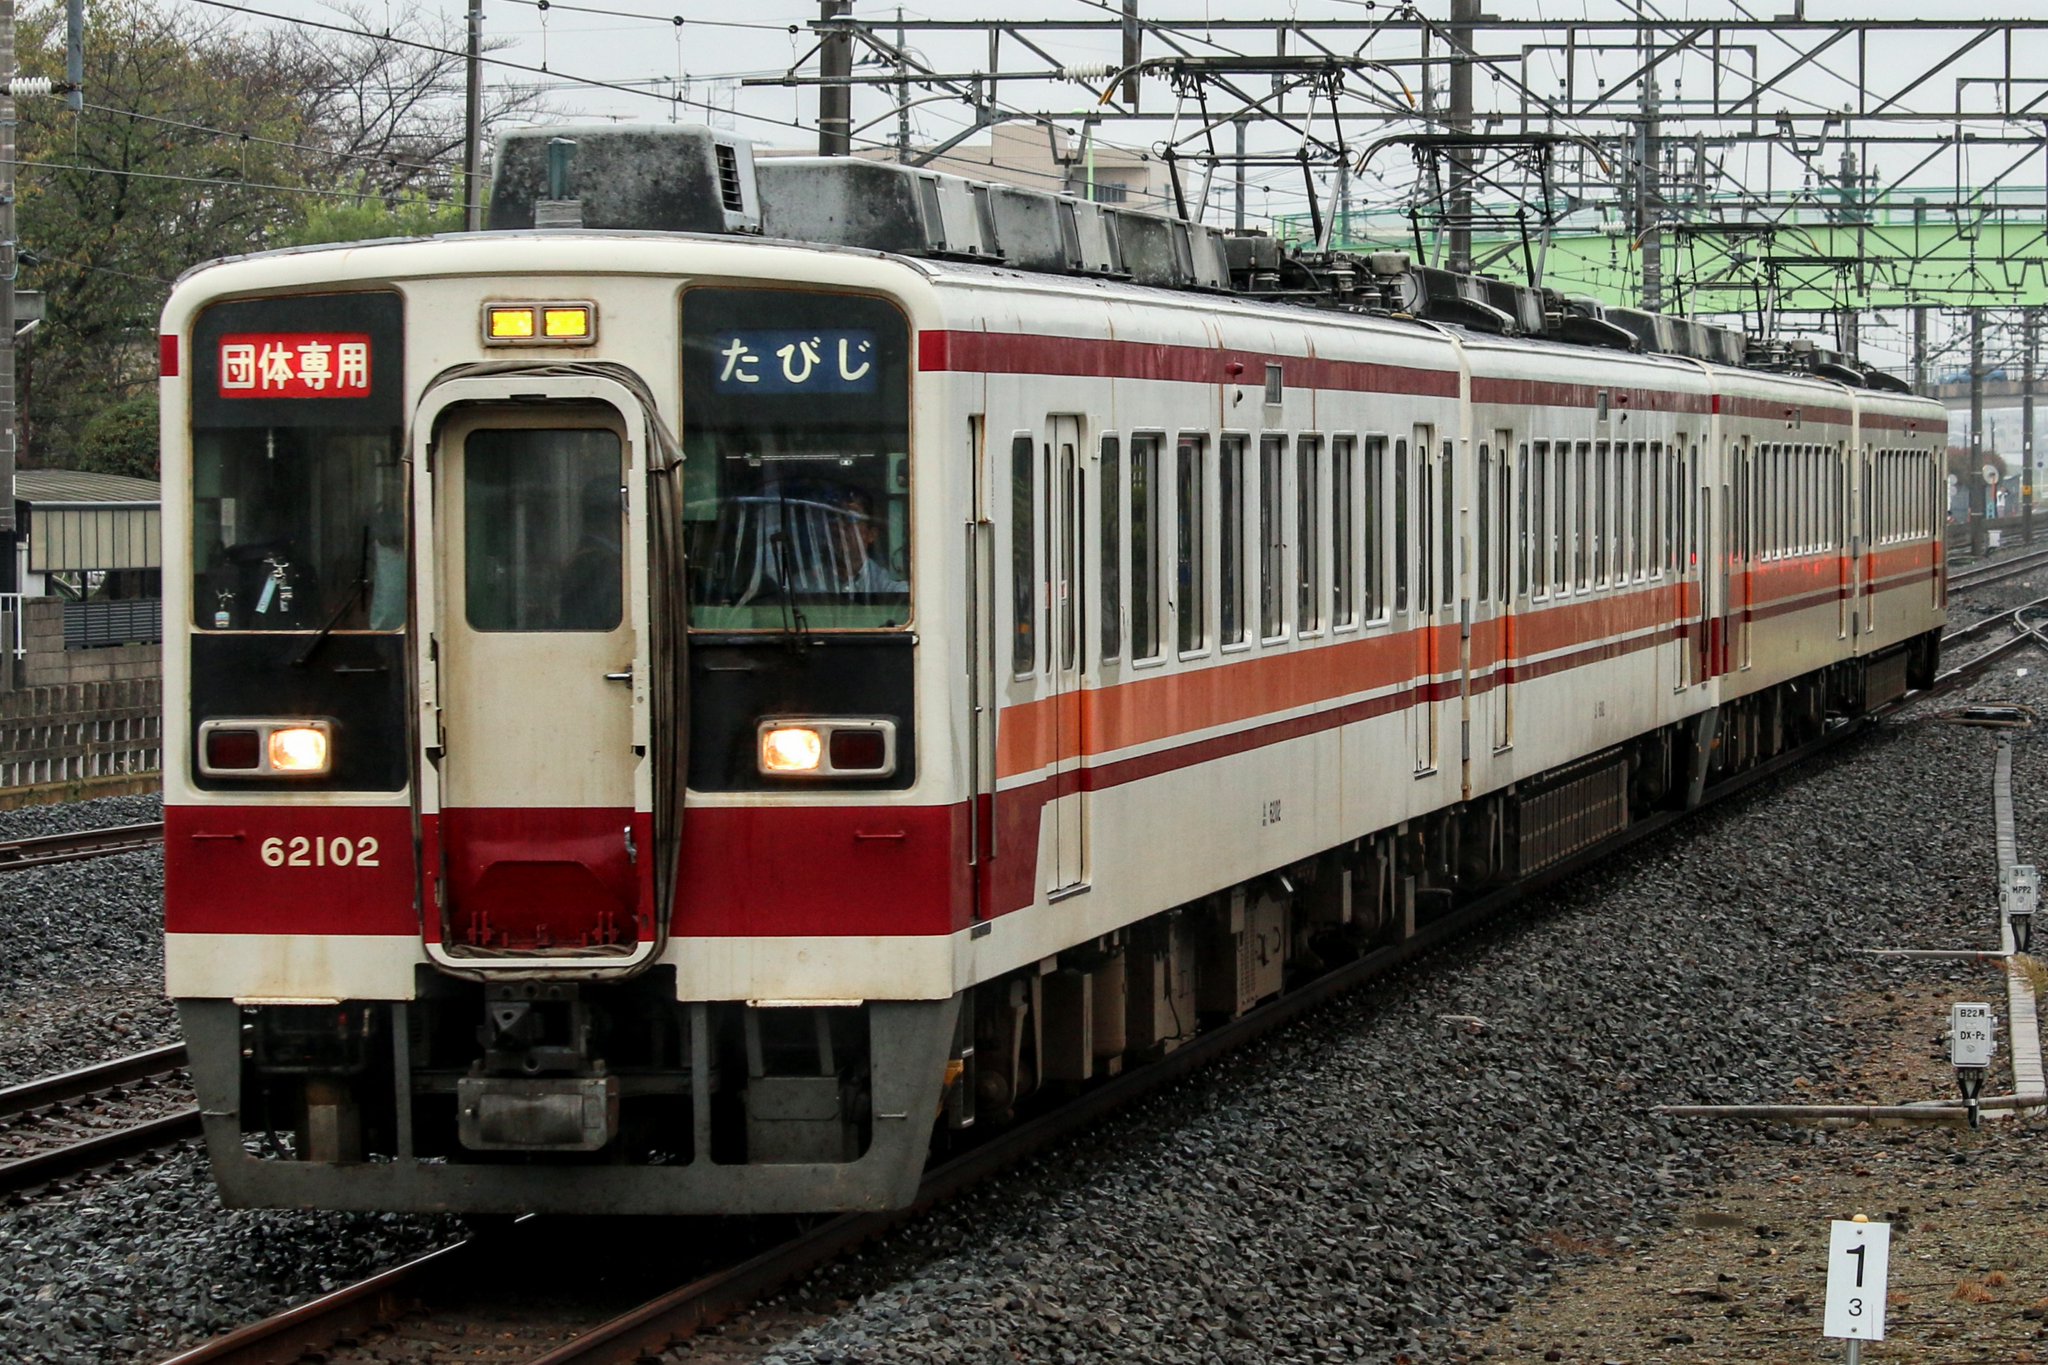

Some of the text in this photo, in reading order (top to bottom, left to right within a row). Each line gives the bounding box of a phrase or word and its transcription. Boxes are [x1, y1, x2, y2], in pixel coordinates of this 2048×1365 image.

[221, 340, 368, 391] 団体専用
[720, 336, 871, 384] たびじ
[260, 836, 380, 867] 62102
[1846, 1244, 1865, 1287] 1
[1848, 1298, 1862, 1317] 3
